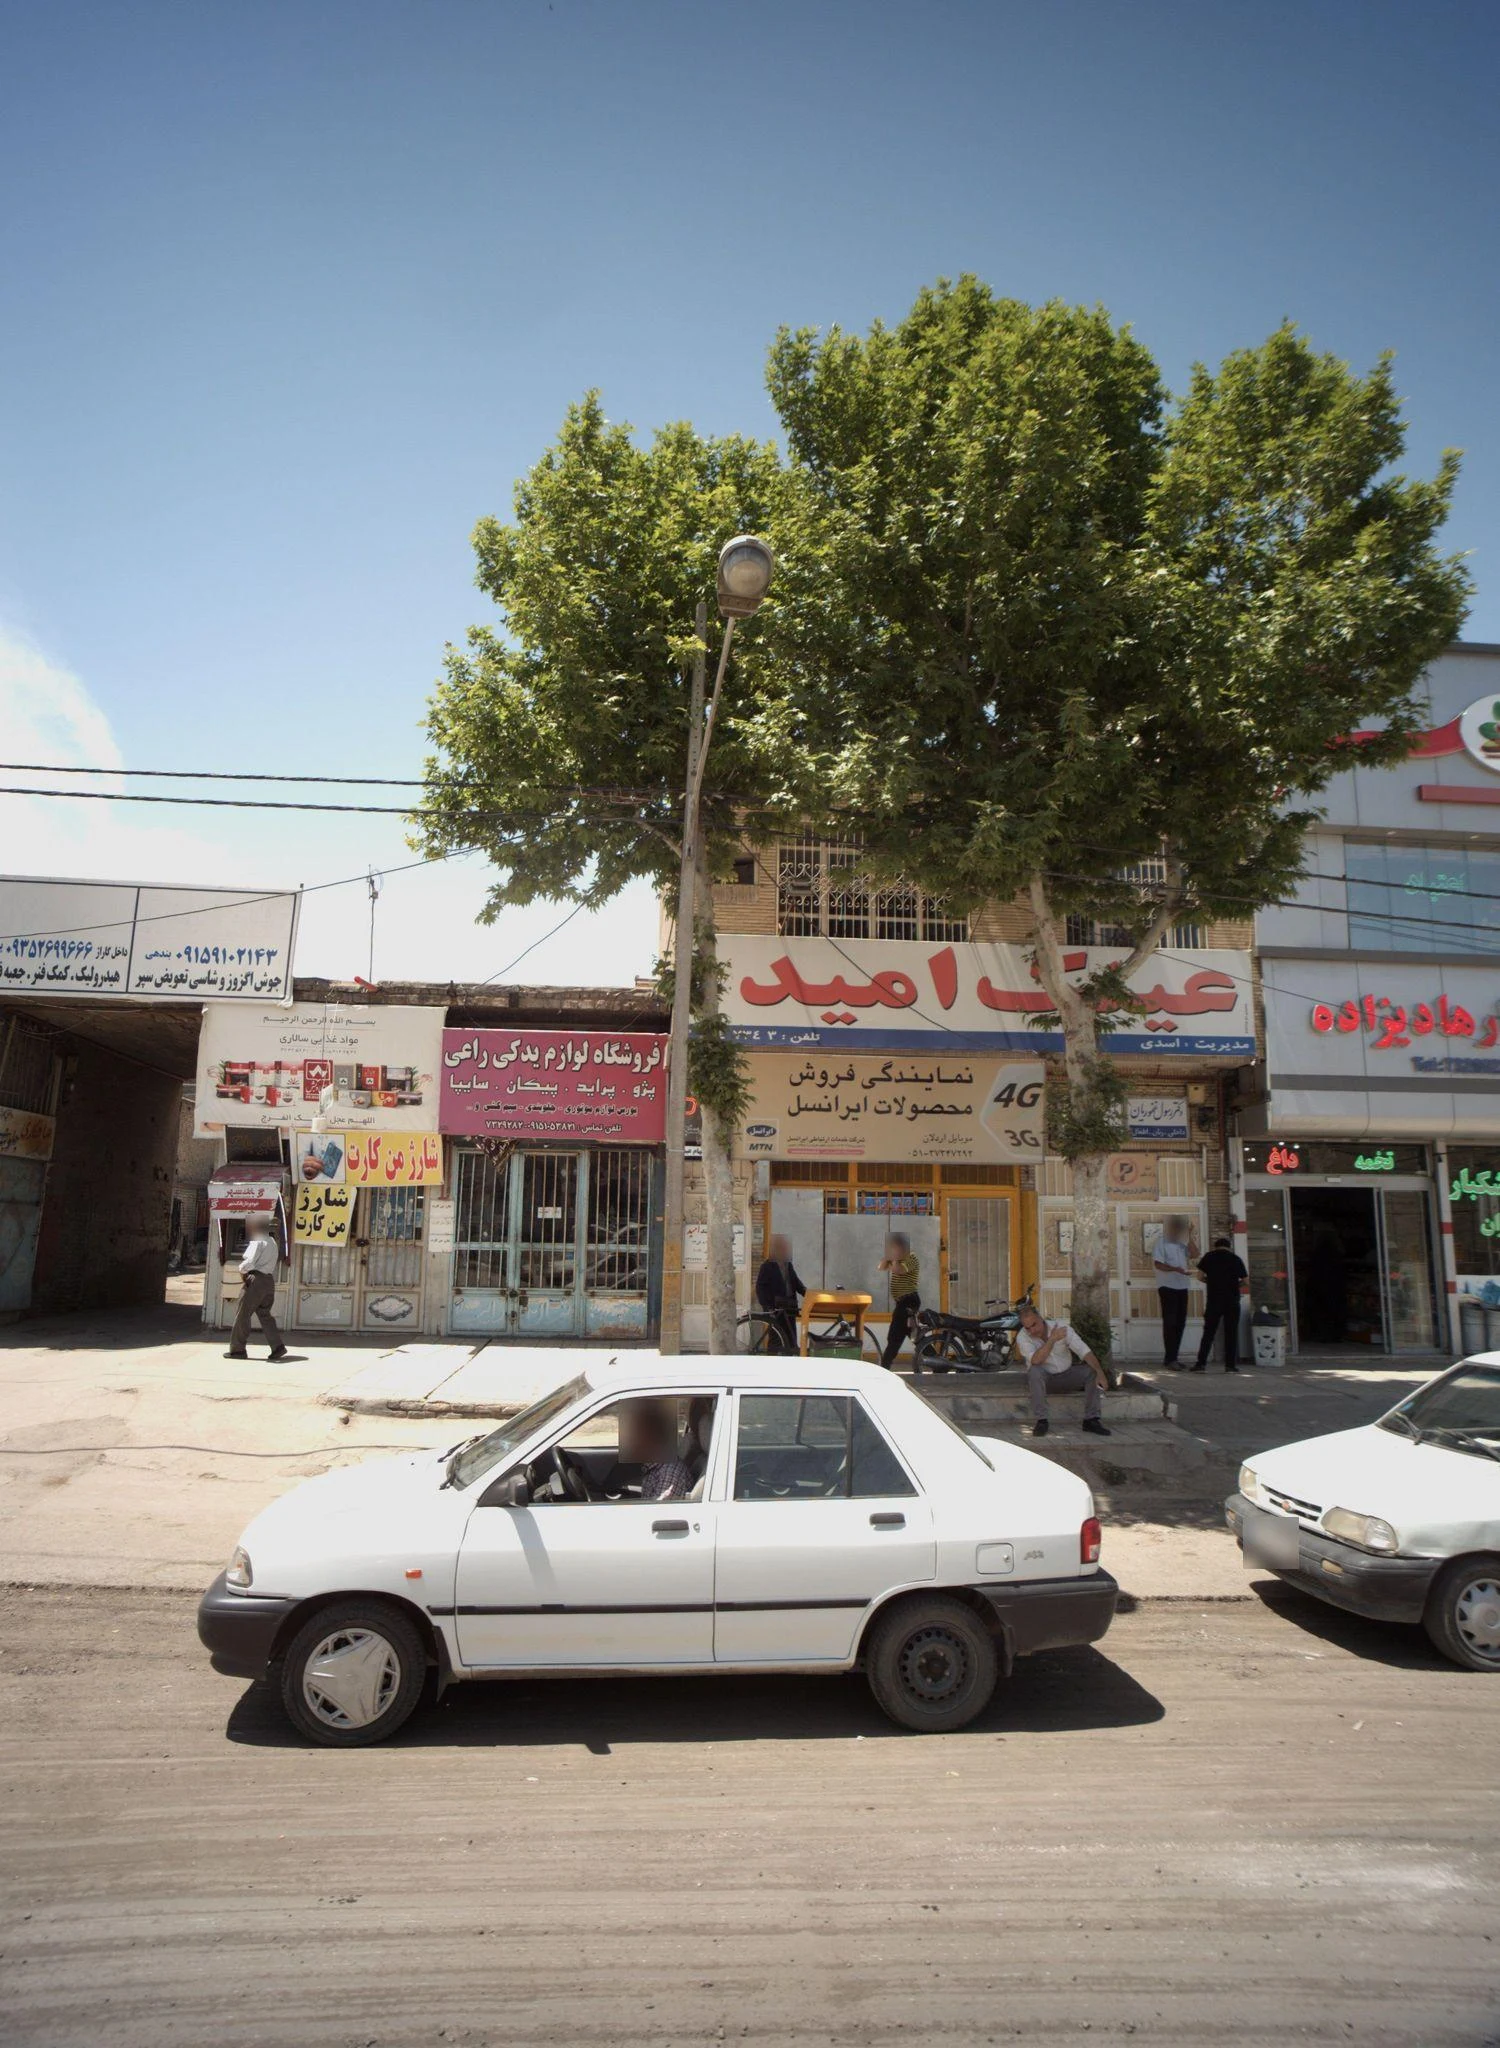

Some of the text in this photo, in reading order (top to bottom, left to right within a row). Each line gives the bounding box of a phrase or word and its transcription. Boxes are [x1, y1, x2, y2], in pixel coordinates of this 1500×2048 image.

[111, 946, 128, 959] داخل
[176, 945, 278, 966] ۰۹۱۵۹۱۰۲۱۴۳
[4, 962, 120, 987] هیدرولیک کمک فنر جعبه
[135, 973, 154, 988] سپر
[154, 968, 188, 989] تعویض
[189, 969, 218, 989] شاسی
[254, 971, 282, 993] جوش
[218, 976, 225, 991] و
[740, 946, 958, 1026] امید
[263, 1015, 299, 1024] الرحیم
[301, 1016, 327, 1025] الرحمن
[345, 1019, 376, 1027] بسم
[280, 1034, 309, 1044] سالاری
[340, 1035, 359, 1046] مواد
[790, 1032, 820, 1043] تلفن
[1140, 1037, 1250, 1052] مدیریت اسدی
[444, 1038, 661, 1073] فروشگاه لوازم یدکی راعی
[789, 1061, 974, 1091] نمایندگی فروش
[450, 1074, 656, 1100] پژو پراید پیکان سایپا
[993, 1082, 1044, 1108] 4G
[787, 1095, 973, 1121] محصولات ایرانسل
[330, 1116, 346, 1125] عجل
[348, 1116, 375, 1125] اللهم
[581, 1122, 602, 1134] تماس
[605, 1123, 621, 1134] تلفن
[750, 1127, 774, 1137] ایرانسل
[1004, 1129, 1041, 1147] 3G
[748, 1143, 773, 1152] MTN
[347, 1136, 439, 1181] شارژ من کارت
[1267, 1146, 1299, 1175] داغ
[298, 1186, 349, 1212] شارژ
[296, 1213, 346, 1238] من کارت
